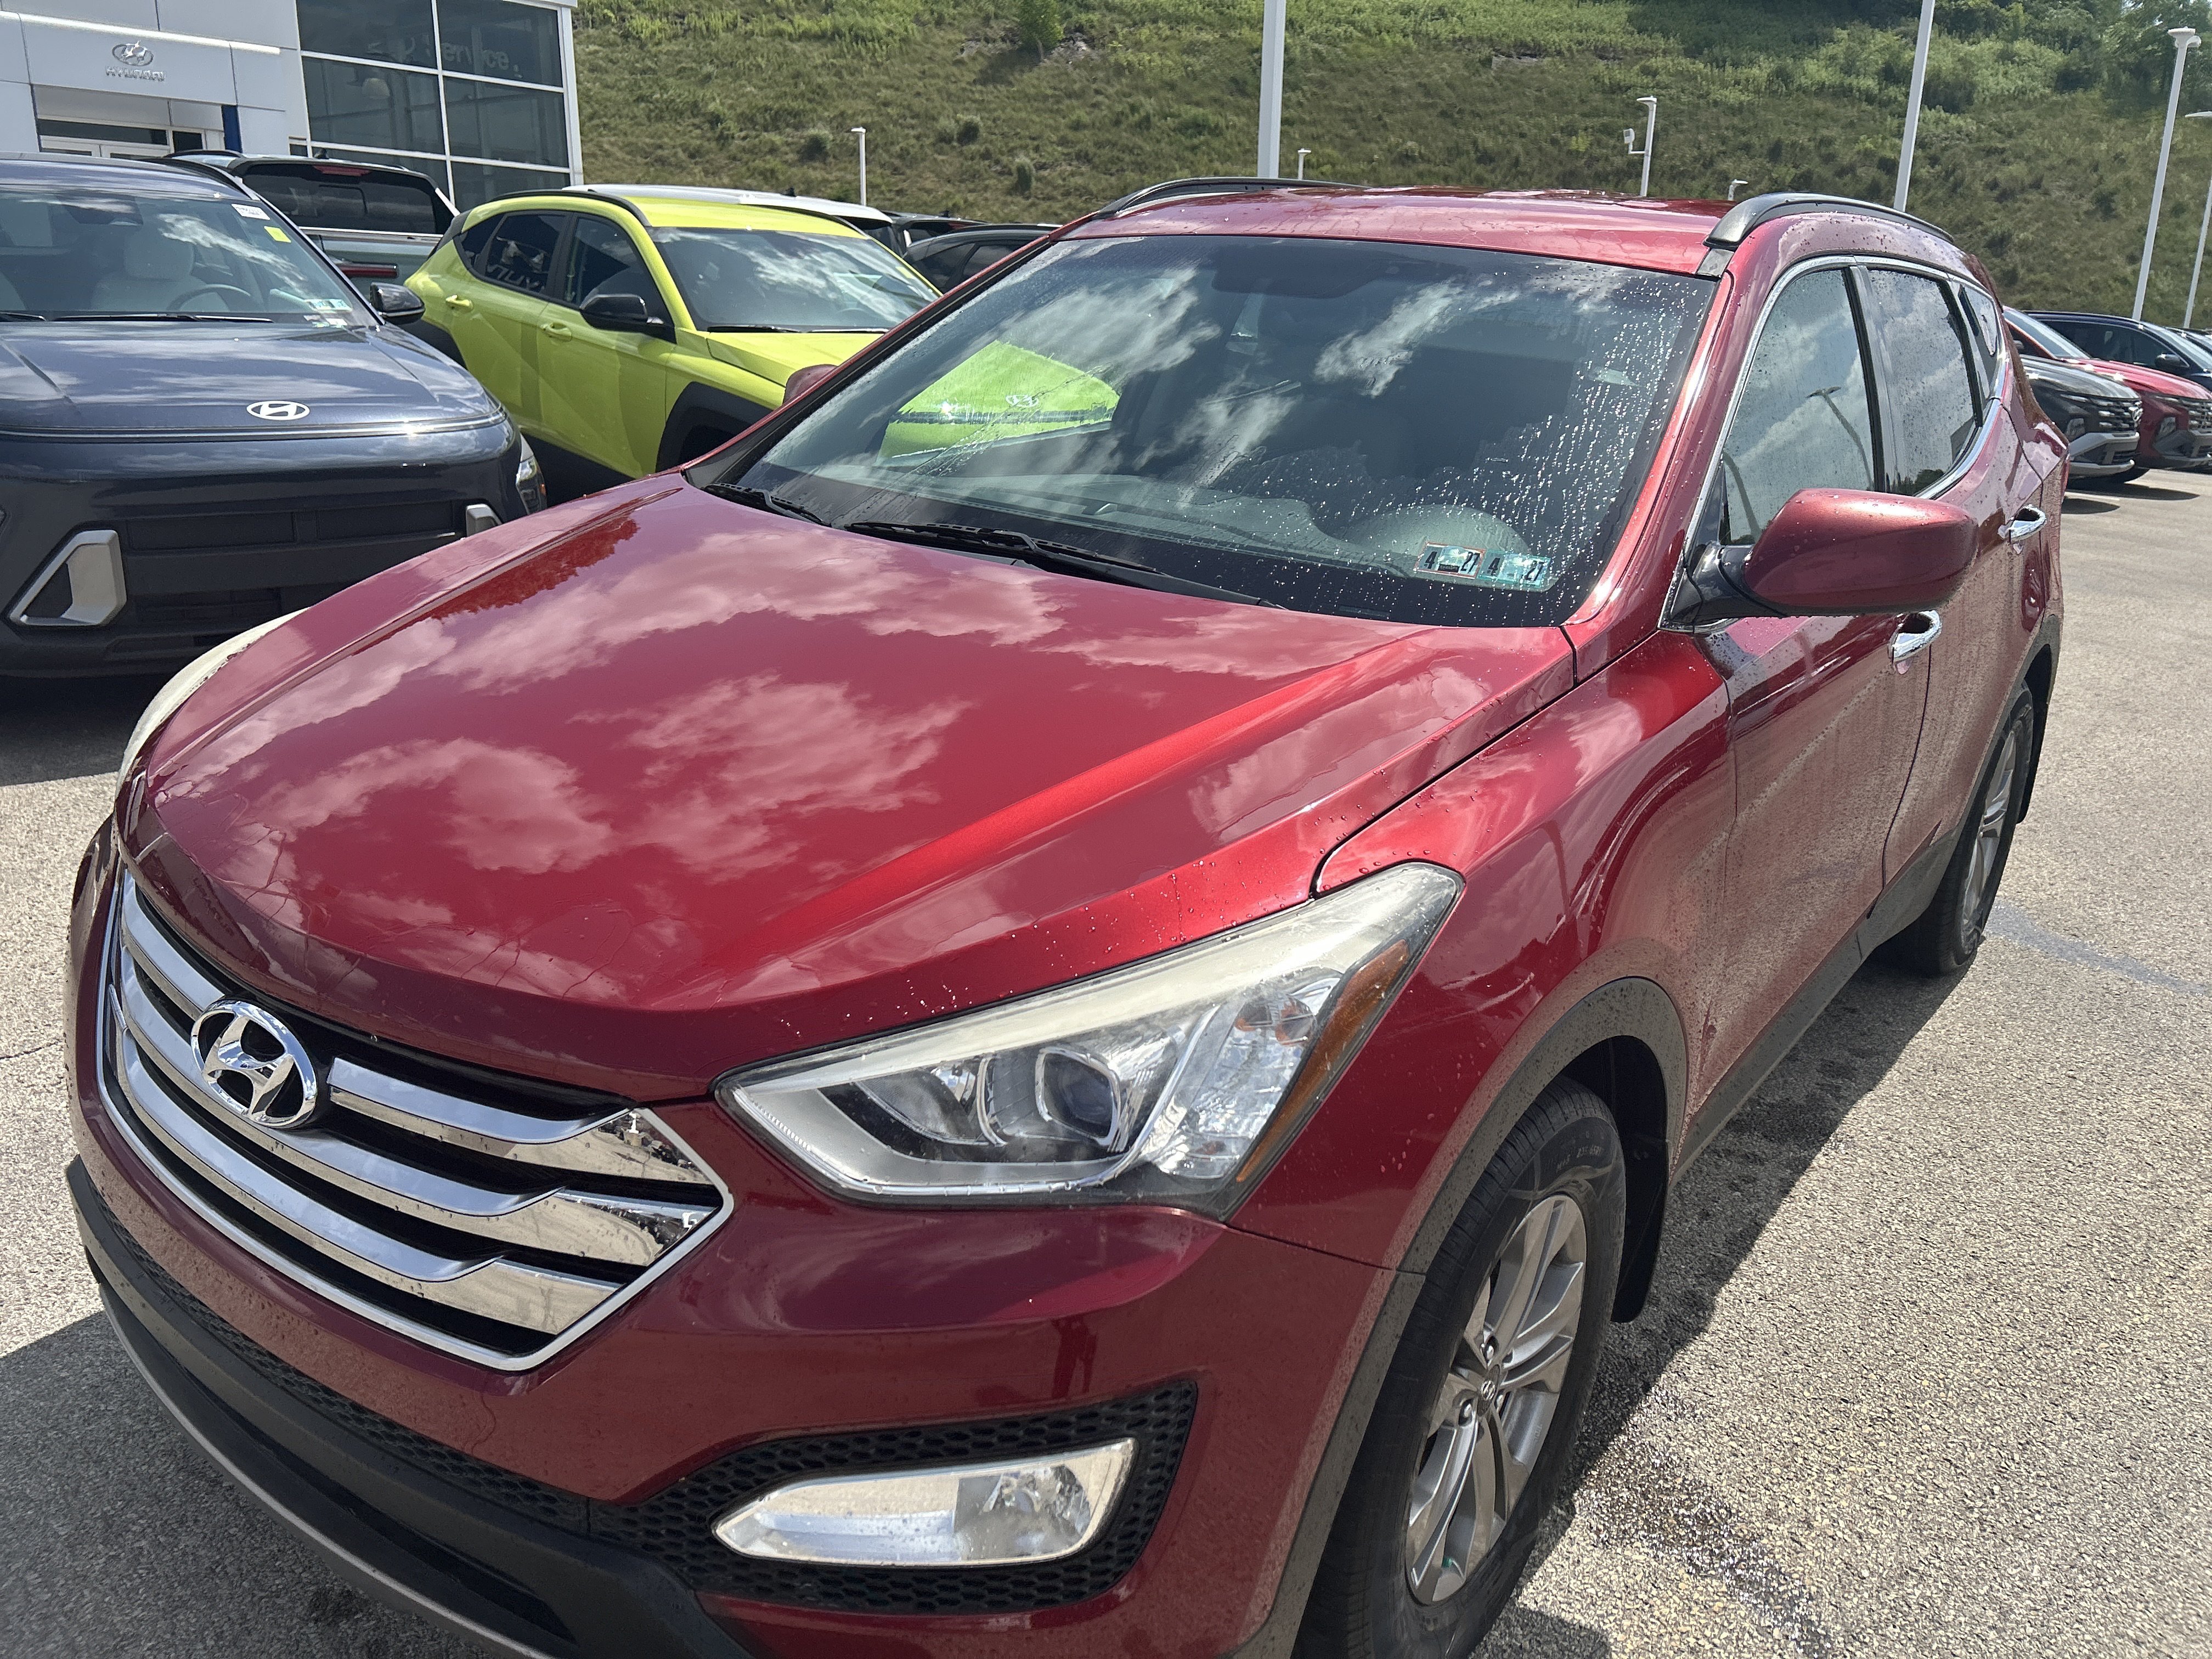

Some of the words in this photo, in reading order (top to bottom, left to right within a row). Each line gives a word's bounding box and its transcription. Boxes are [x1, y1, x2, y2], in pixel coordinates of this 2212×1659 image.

[1425, 551, 1438, 569] 4
[1460, 551, 1481, 574] 27
[1488, 557, 1500, 576] 4
